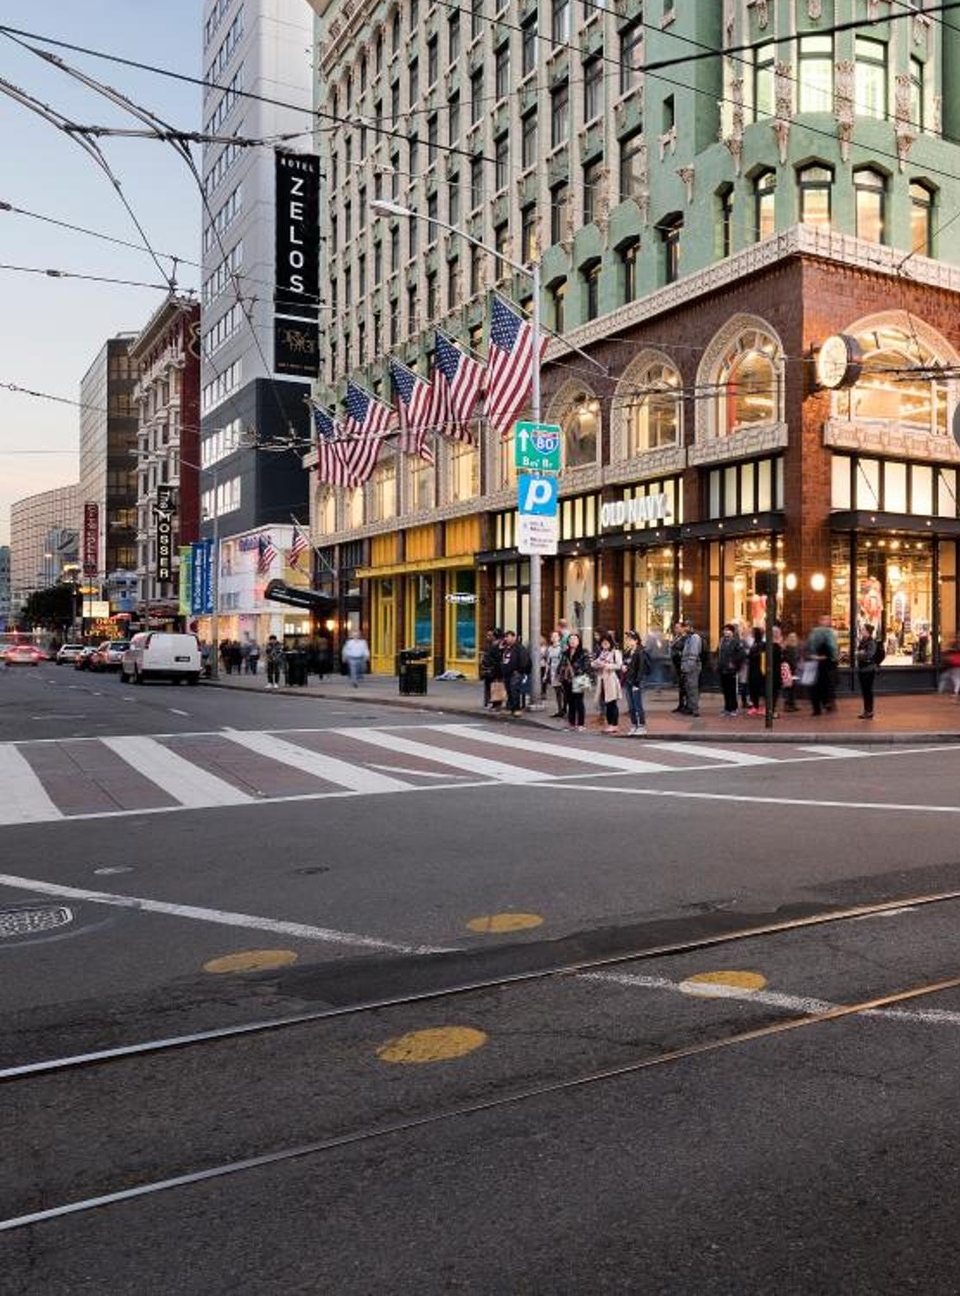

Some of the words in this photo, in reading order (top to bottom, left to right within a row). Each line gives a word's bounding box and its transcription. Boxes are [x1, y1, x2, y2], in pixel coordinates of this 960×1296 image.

[289, 176, 305, 294] ZELOS
[536, 436, 554, 450] 80
[602, 501, 625, 528] OLD
[628, 494, 665, 524] NAVY
[159, 513, 171, 579] MOSSER
